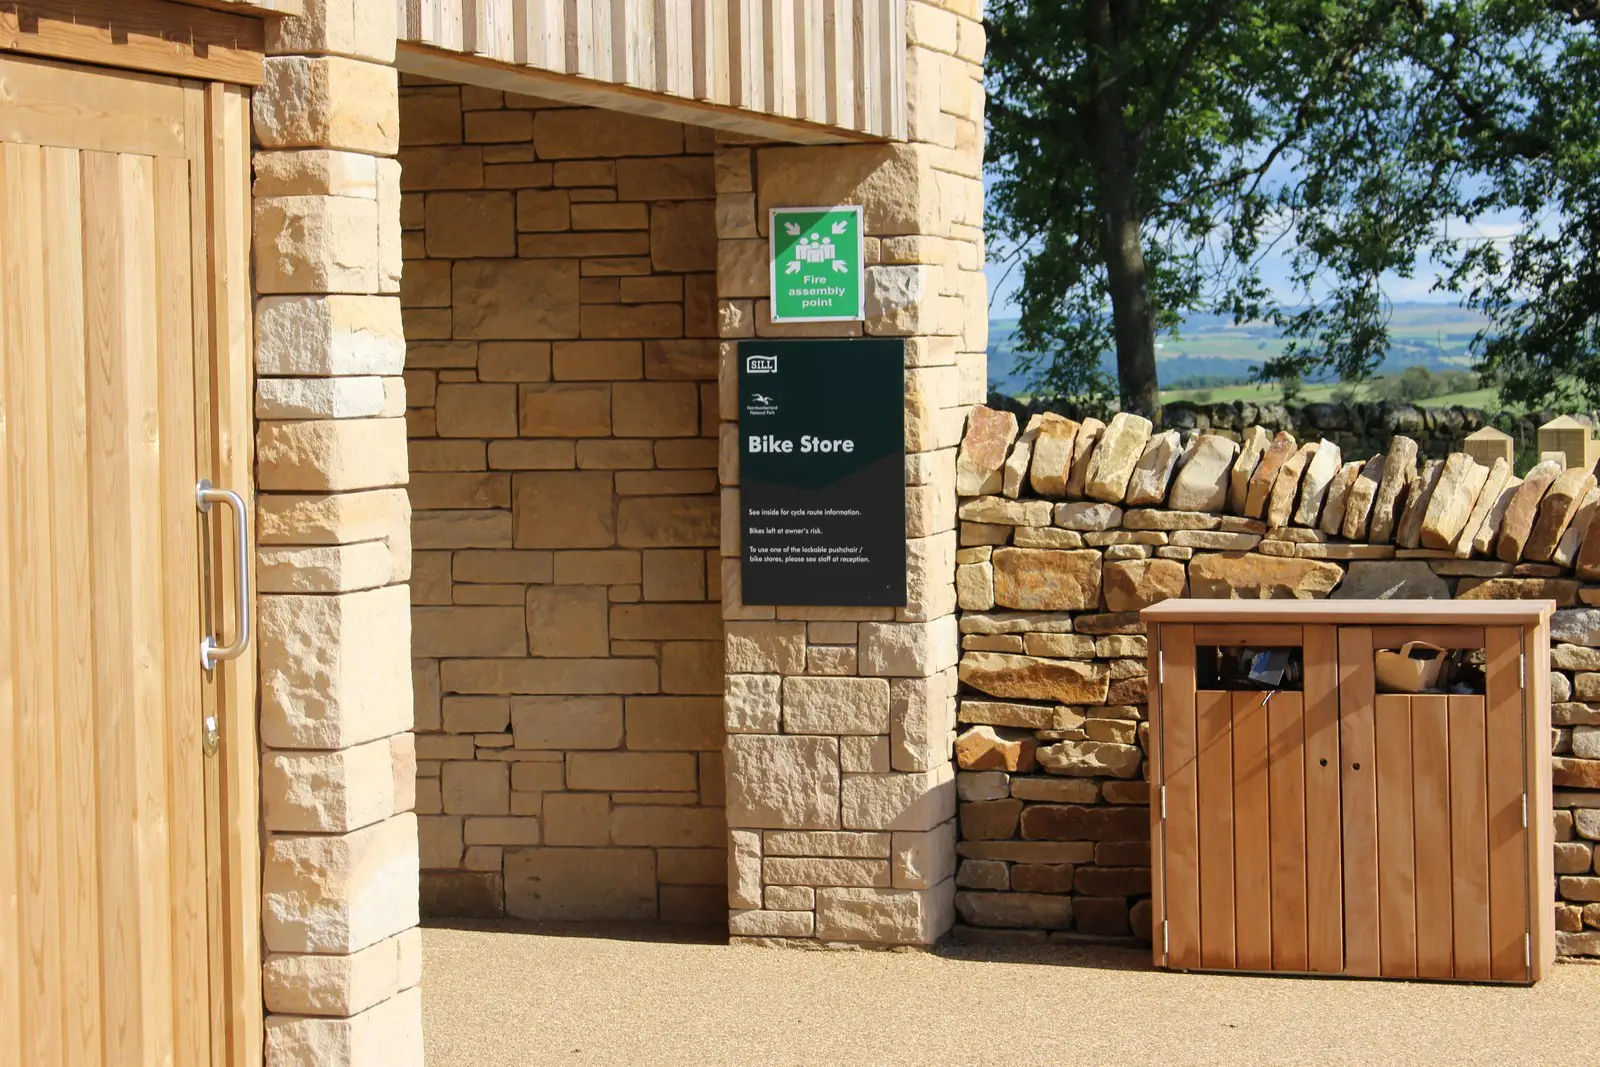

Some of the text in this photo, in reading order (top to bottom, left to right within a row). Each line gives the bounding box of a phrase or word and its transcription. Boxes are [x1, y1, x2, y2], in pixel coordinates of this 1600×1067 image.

[803, 275, 827, 285] Fire
[788, 286, 846, 297] assembly
[802, 298, 833, 309] point
[751, 360, 773, 369] SILL
[748, 434, 855, 453] Bike Store
[749, 508, 862, 517] See inside for cycle route information.
[828, 546, 858, 554] pushchair
[764, 555, 784, 563] stores,
[785, 555, 805, 564] please
[840, 555, 870, 564] reception.
